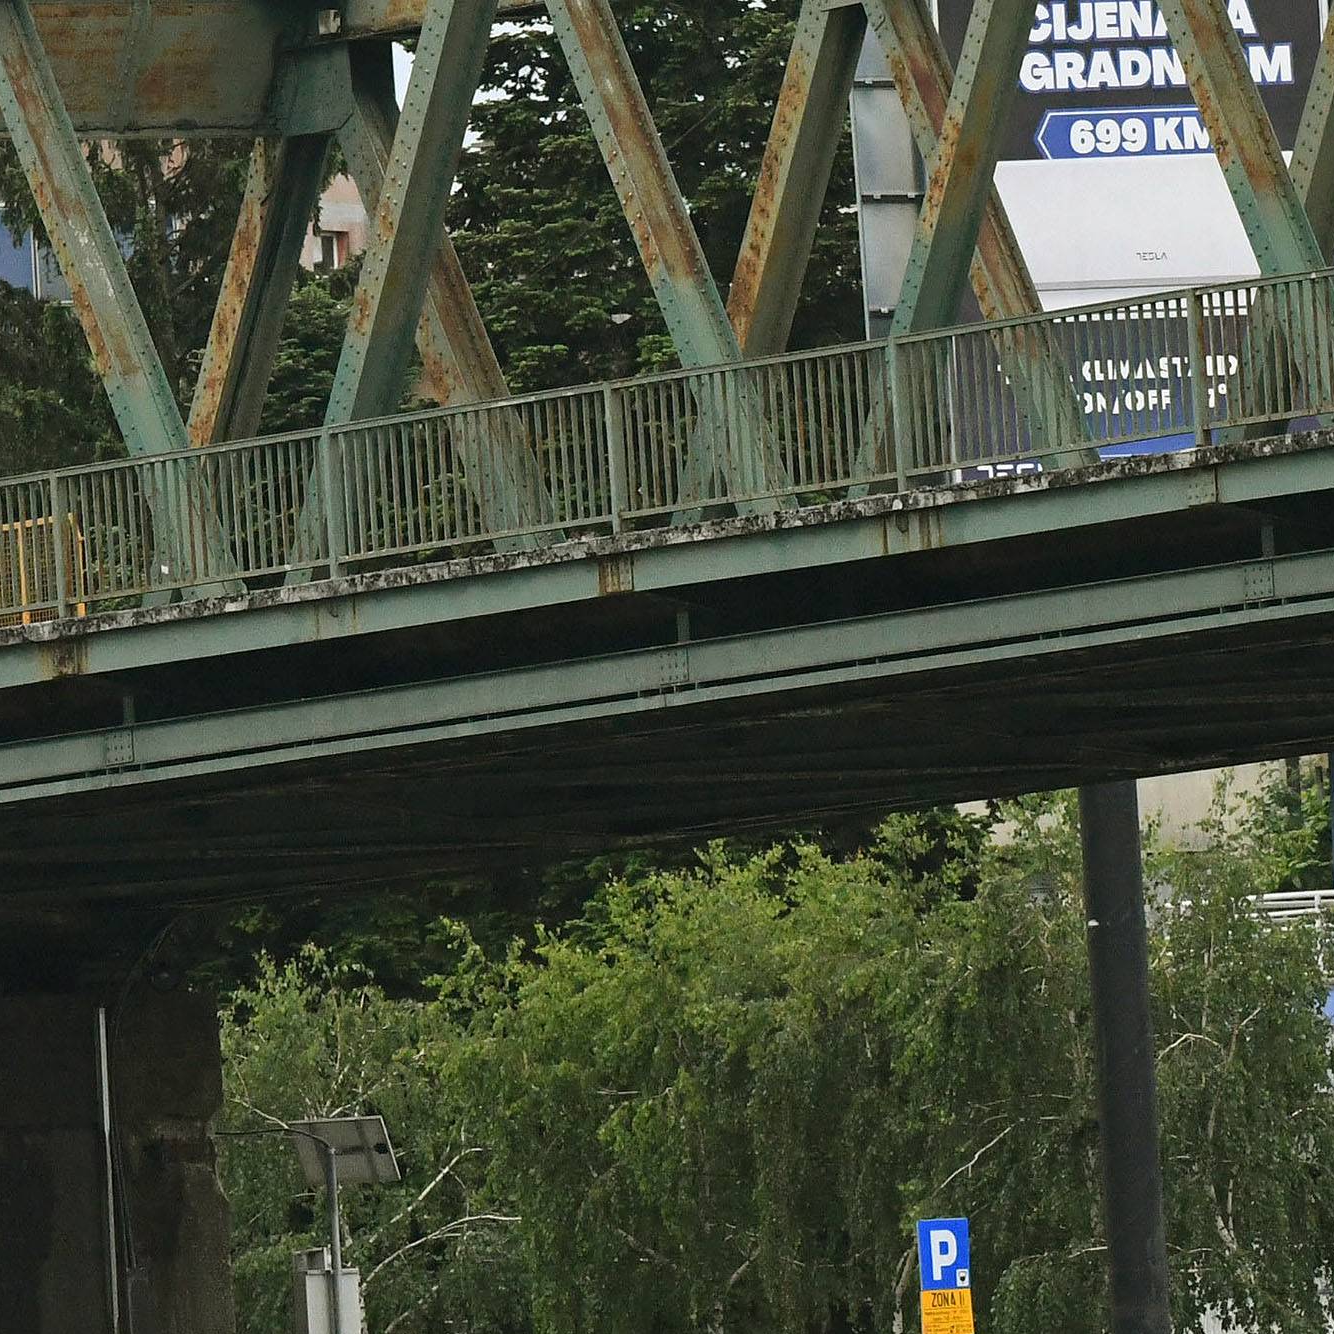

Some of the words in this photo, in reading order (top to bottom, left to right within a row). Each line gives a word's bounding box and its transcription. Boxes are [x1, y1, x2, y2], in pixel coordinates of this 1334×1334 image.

[1069, 118, 1148, 154] 699
[1153, 116, 1211, 151] KM
[930, 1229, 957, 1281] P
[931, 1291, 956, 1308] ZONA
